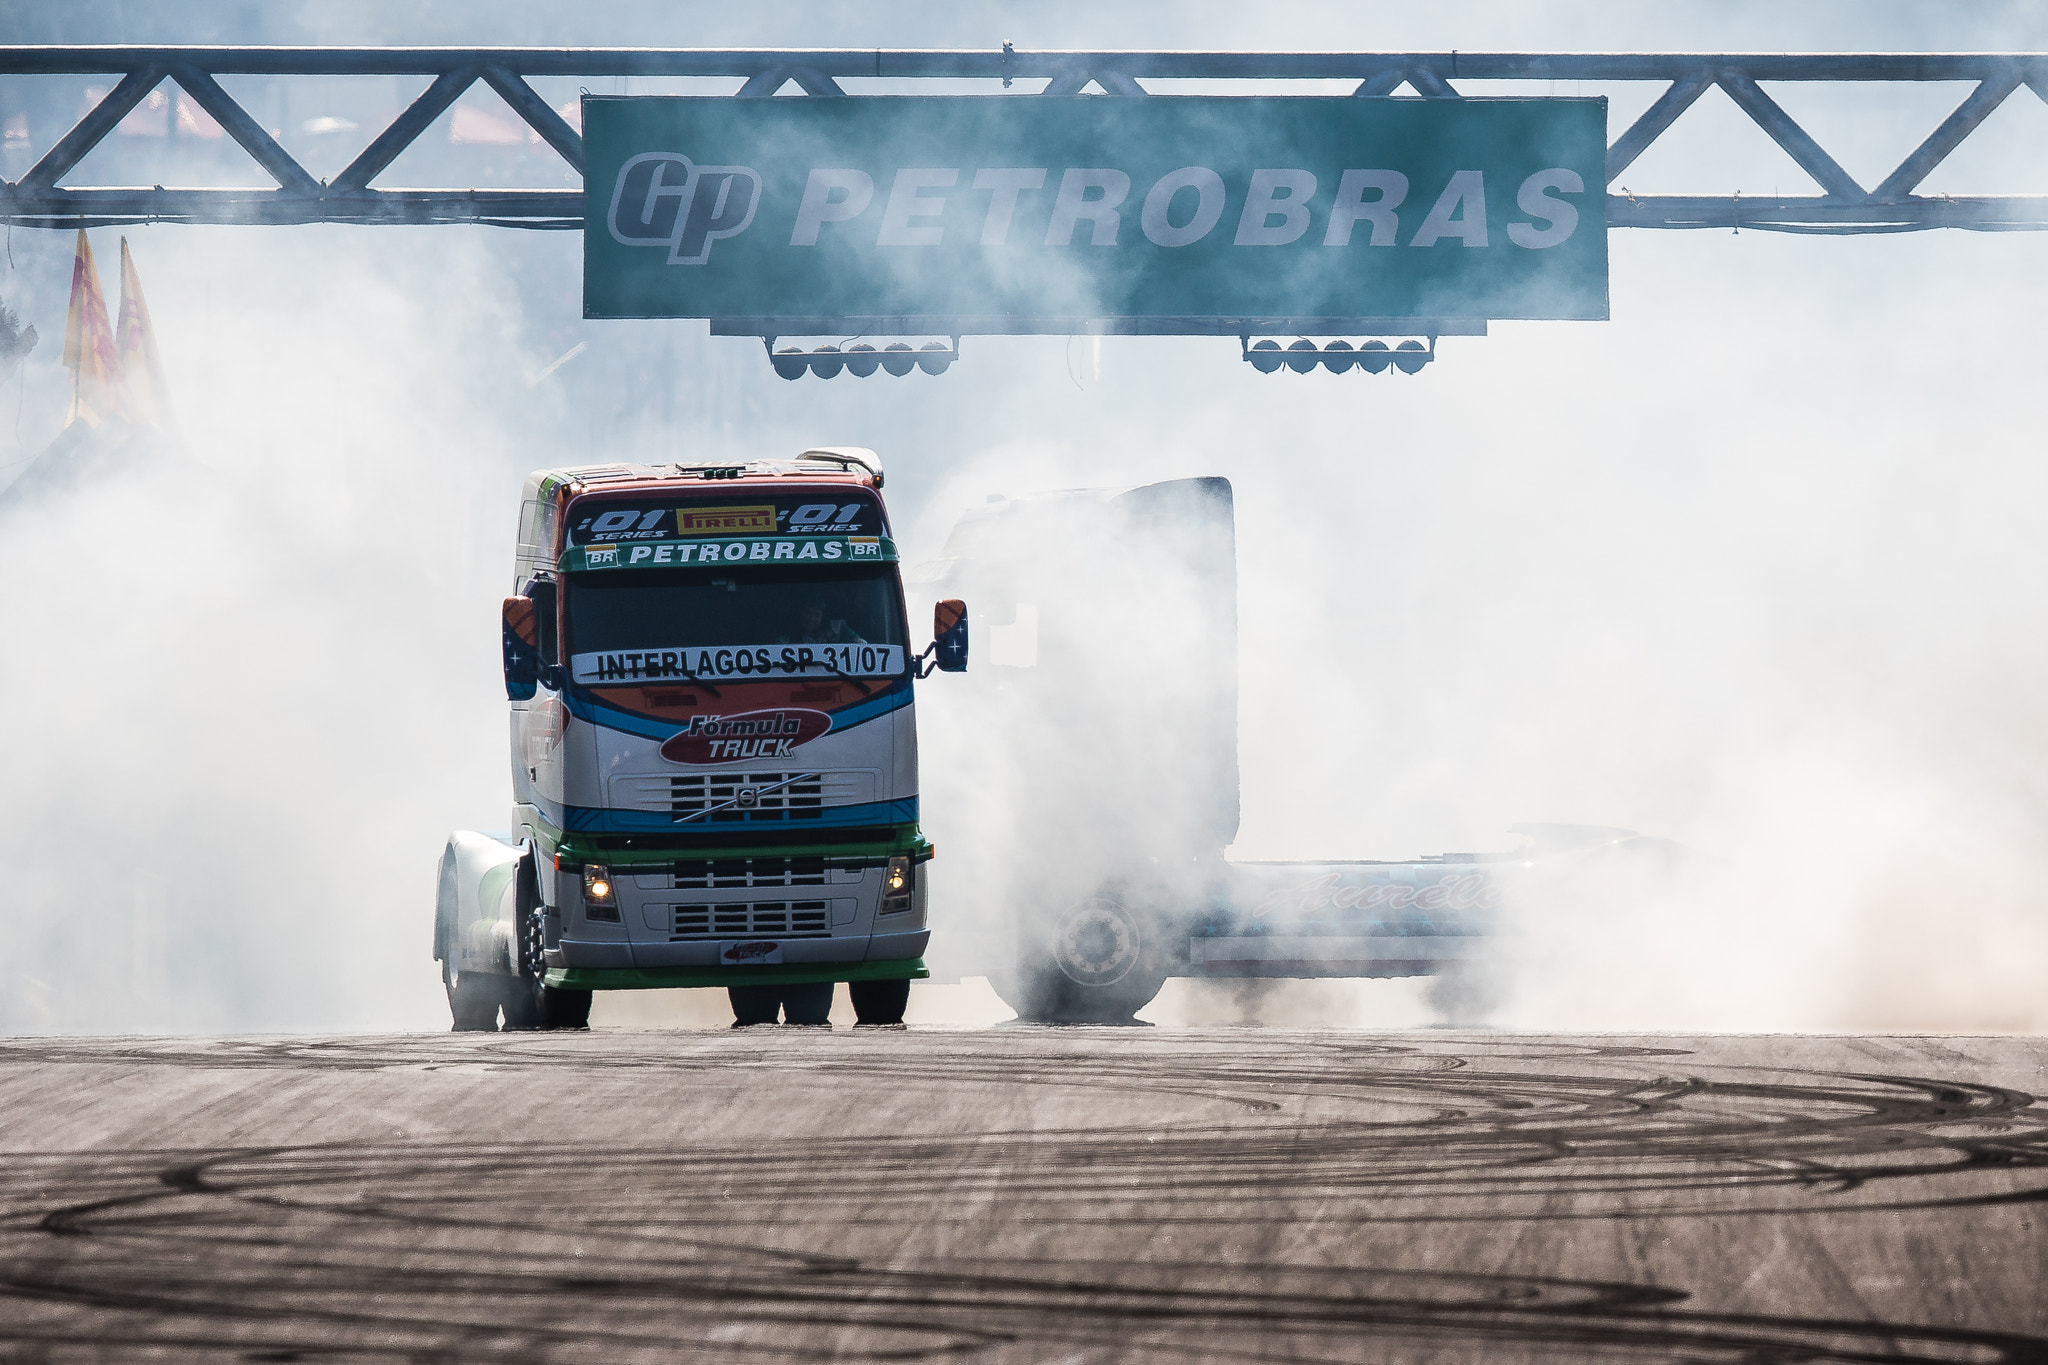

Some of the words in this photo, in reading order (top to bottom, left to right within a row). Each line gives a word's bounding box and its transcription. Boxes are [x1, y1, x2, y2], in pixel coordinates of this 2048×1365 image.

[789, 166, 1585, 249] PETROBRAS
[682, 510, 771, 529] PIRELLI
[786, 524, 863, 533] SERIES
[590, 530, 669, 542] SERIES
[589, 551, 614, 564] BR
[629, 541, 843, 564] PETROBRAS
[854, 544, 878, 555] BR
[823, 646, 891, 673] 31/07
[708, 737, 795, 759] TRUCK
